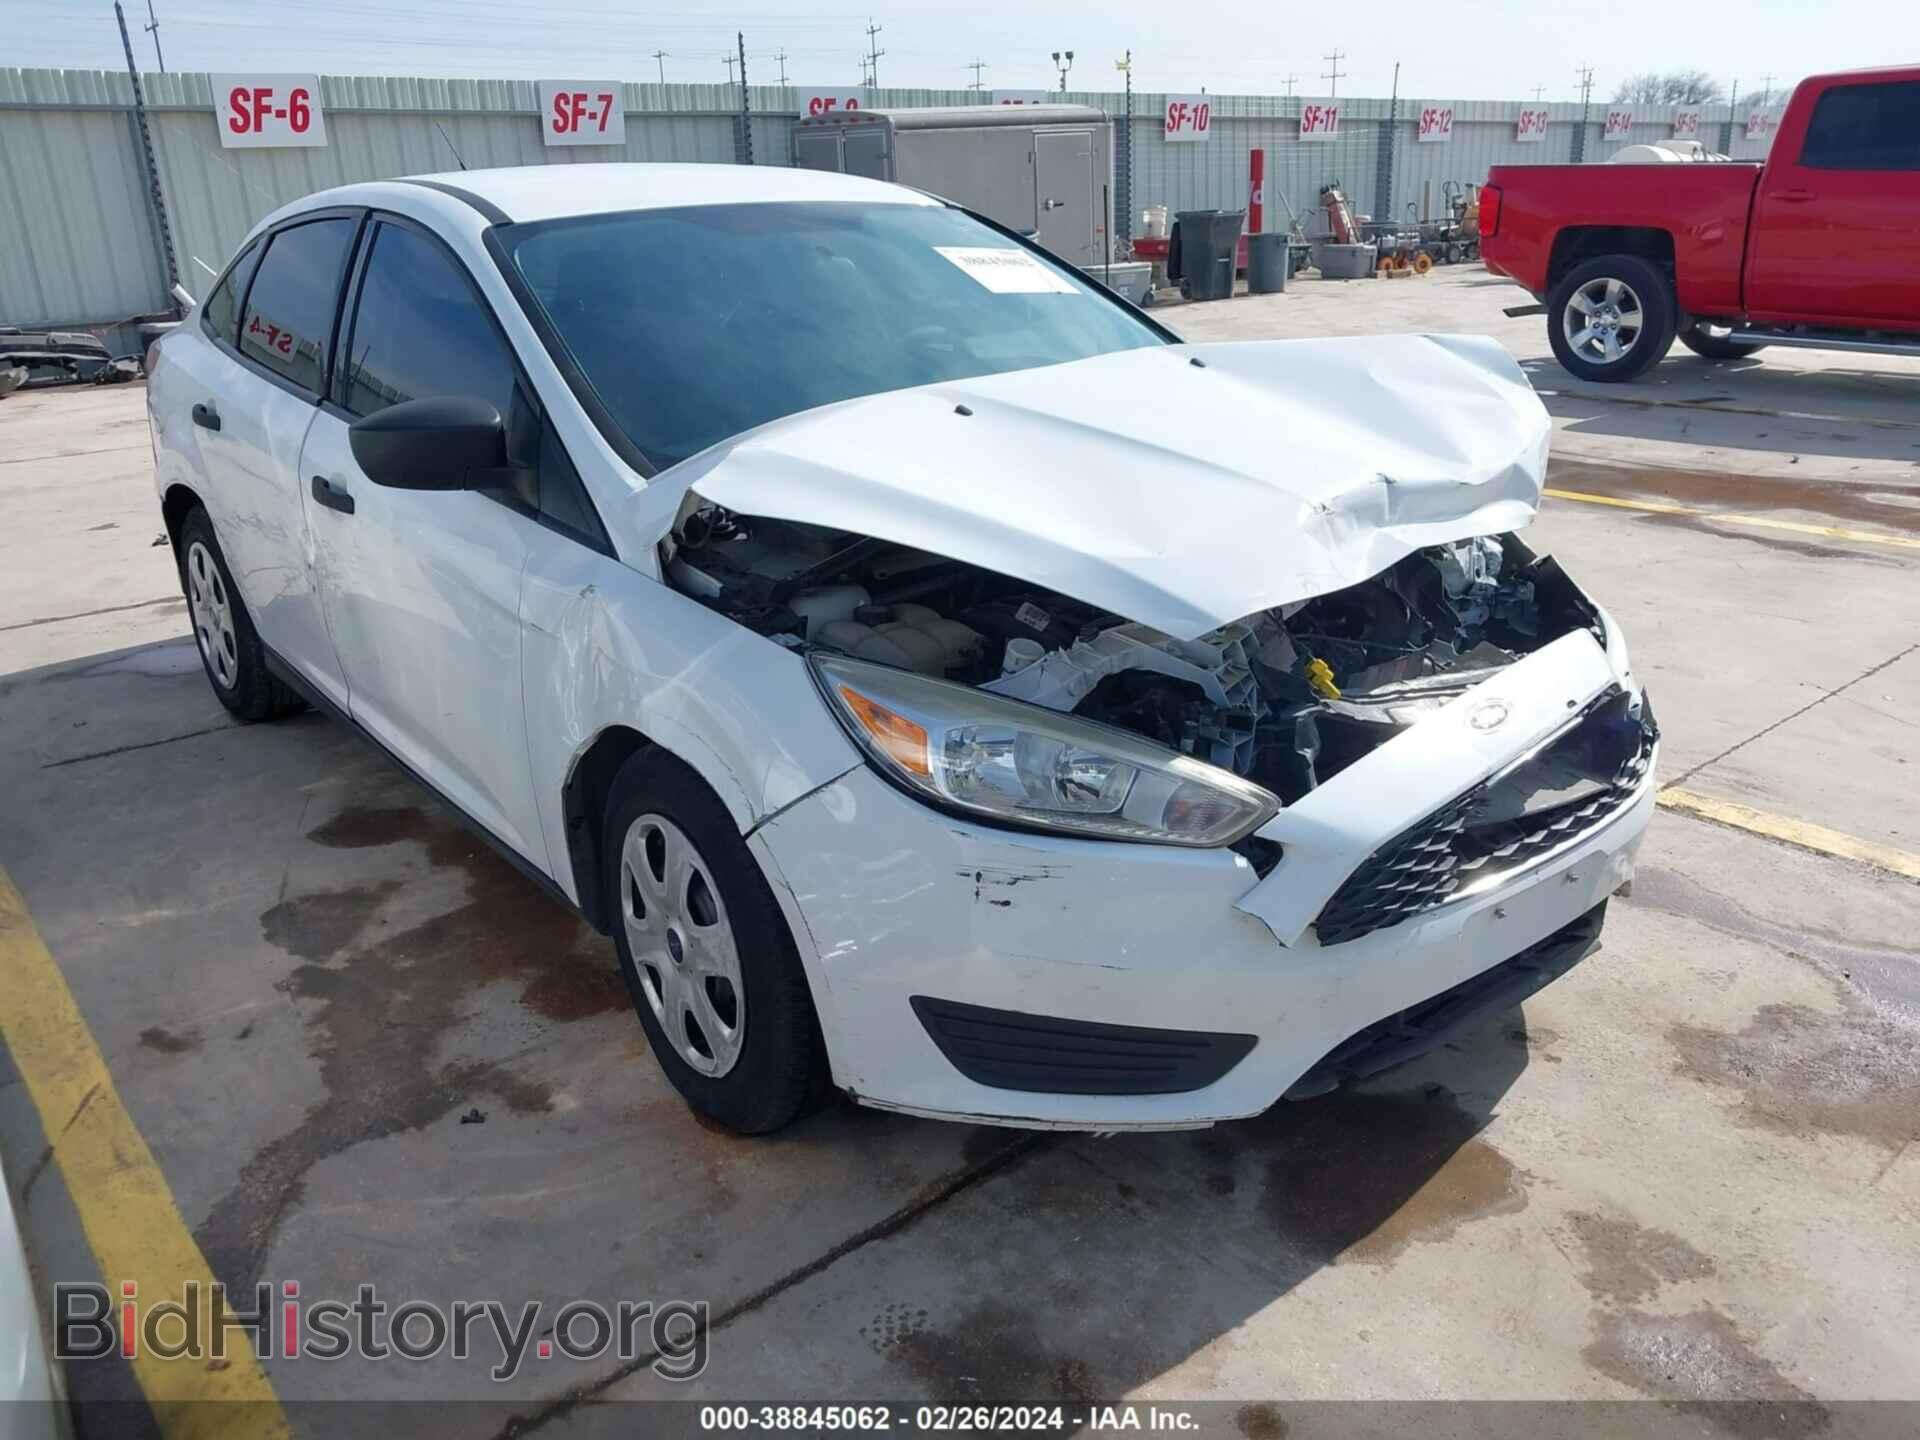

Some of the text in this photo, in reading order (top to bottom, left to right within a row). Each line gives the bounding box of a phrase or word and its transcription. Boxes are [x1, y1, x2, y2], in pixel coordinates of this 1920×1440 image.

[229, 87, 310, 134] SF-6
[552, 92, 614, 133] SF-7
[1167, 103, 1210, 132] SF-10
[1302, 106, 1338, 132] SF-11
[1420, 109, 1452, 134] SF-12
[1519, 110, 1549, 133] SF-13
